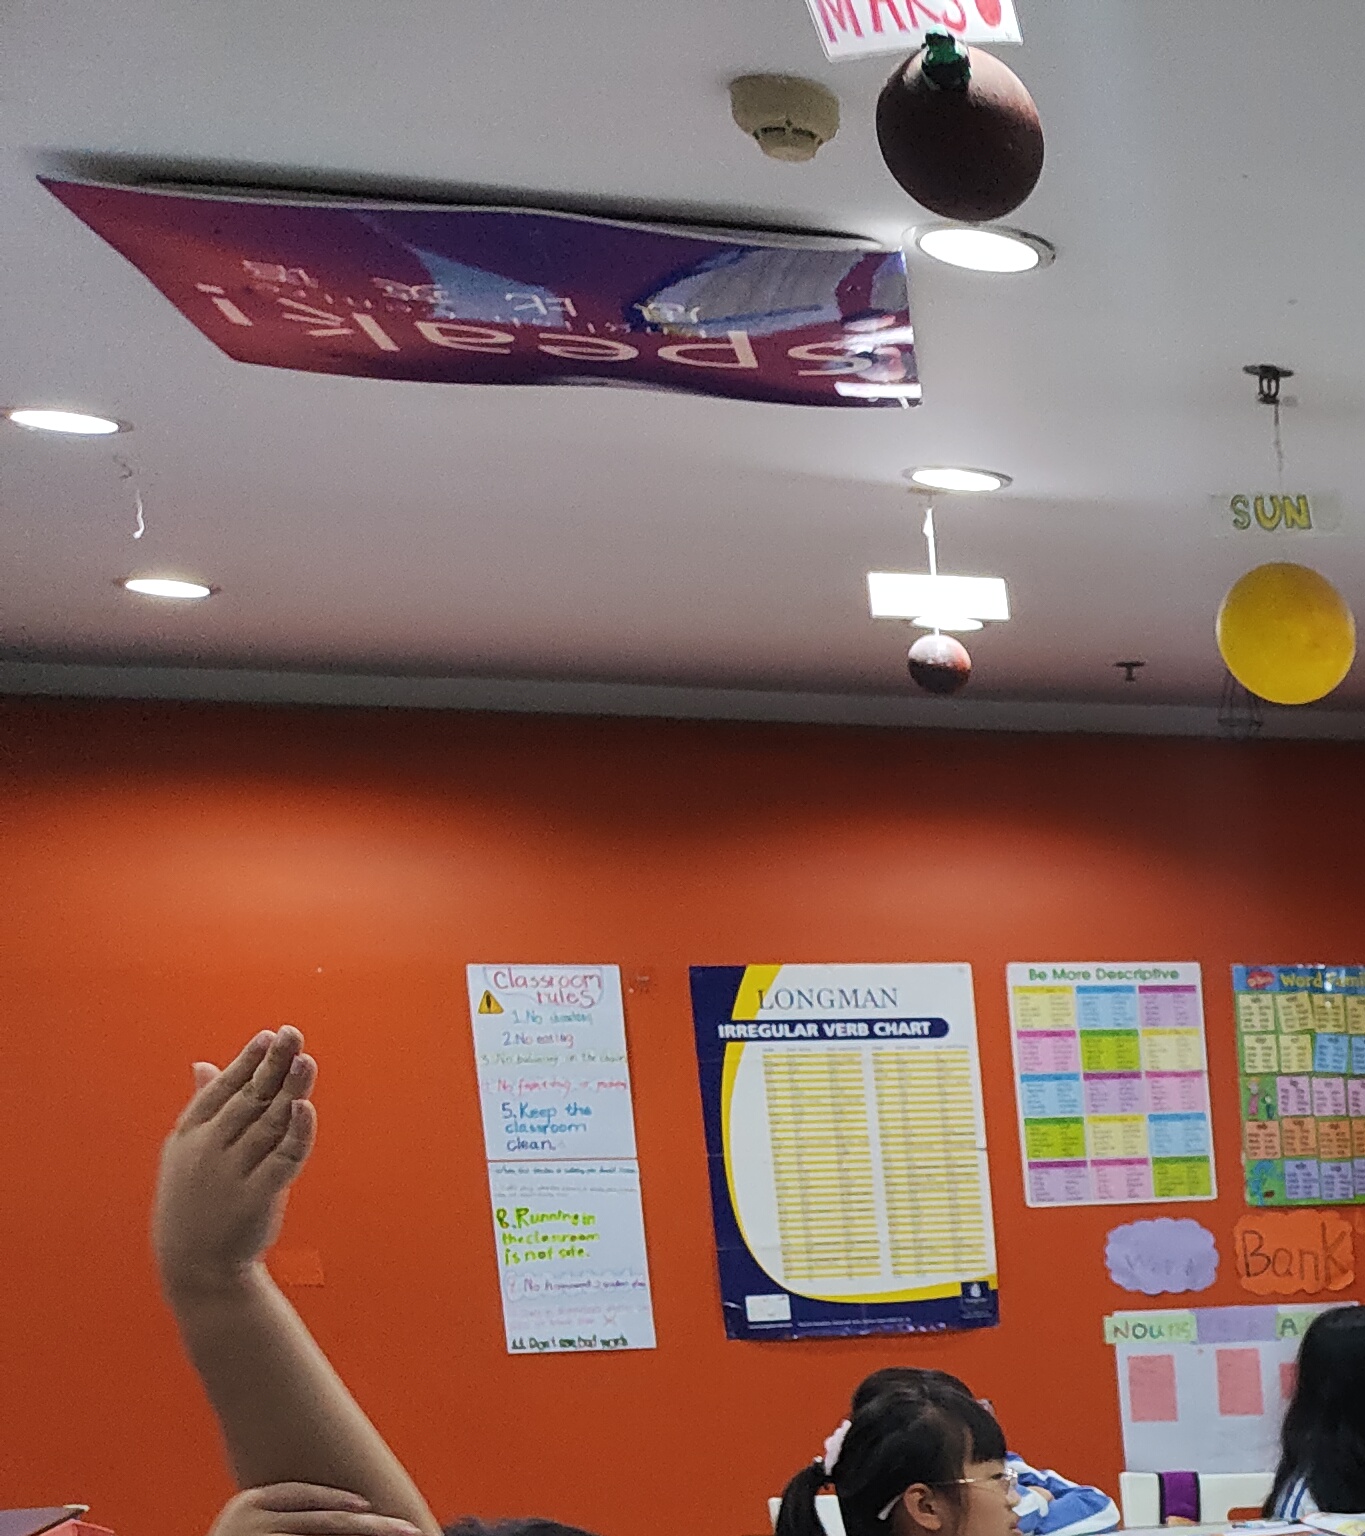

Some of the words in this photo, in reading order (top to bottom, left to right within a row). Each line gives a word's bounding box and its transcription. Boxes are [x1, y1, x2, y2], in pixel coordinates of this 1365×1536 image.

[1229, 493, 1313, 531] SUN
[493, 967, 602, 991] Classroom
[1029, 968, 1047, 981] Be
[1052, 968, 1091, 981] More
[1096, 967, 1180, 982] Descriptive
[1280, 972, 1322, 988] Word
[758, 987, 898, 1010] LONGMAN
[718, 1021, 819, 1039] IRREGULAR
[822, 1022, 869, 1037] VERB
[873, 1021, 932, 1036] CHART
